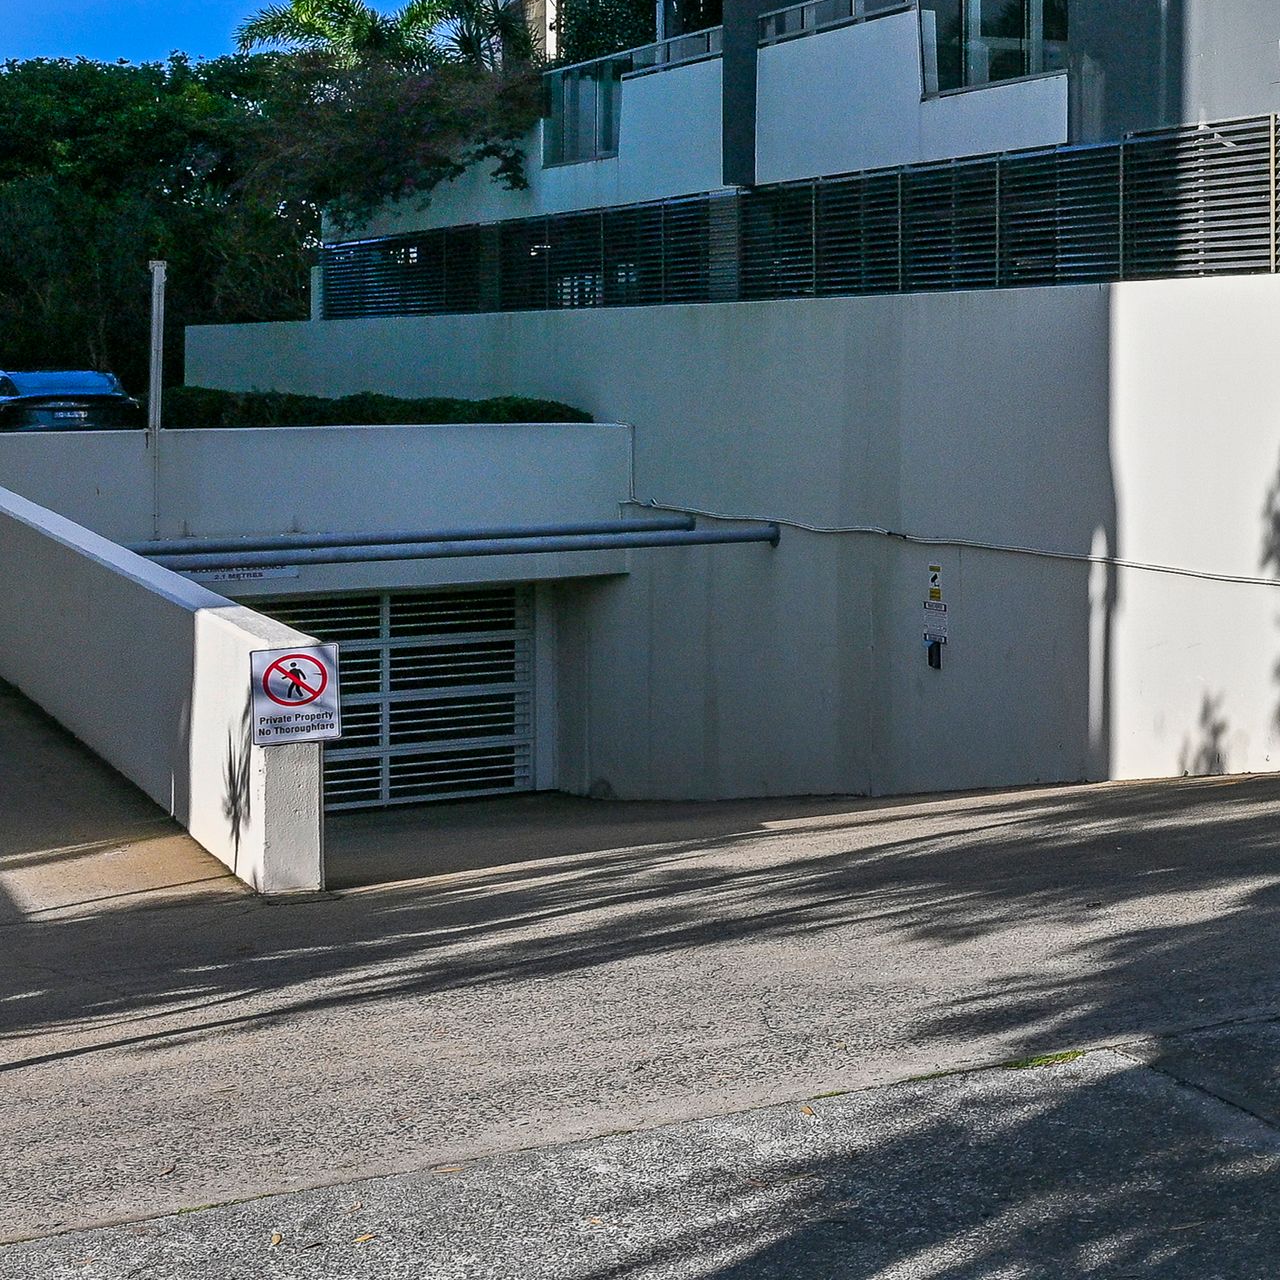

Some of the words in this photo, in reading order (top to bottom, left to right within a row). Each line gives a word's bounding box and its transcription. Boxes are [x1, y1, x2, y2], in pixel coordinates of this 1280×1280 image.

[227, 572, 264, 580] METRES
[259, 715, 292, 725] Private
[294, 711, 334, 722] Property
[258, 728, 272, 736] No
[274, 722, 335, 735] Thoroughfare
